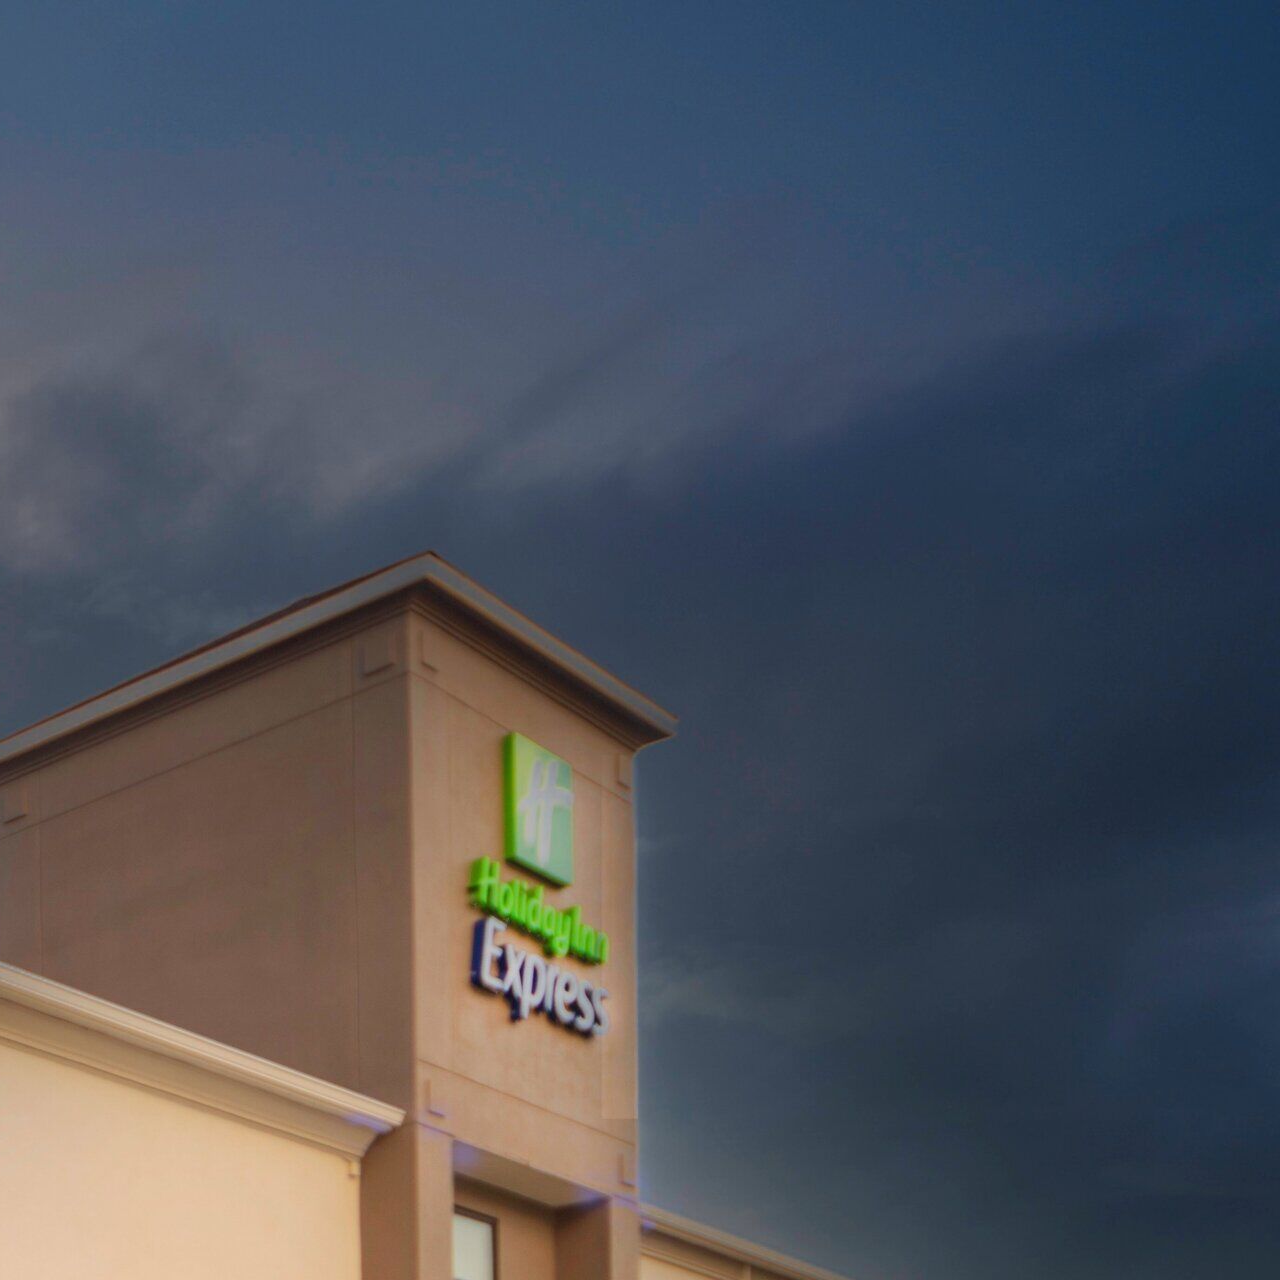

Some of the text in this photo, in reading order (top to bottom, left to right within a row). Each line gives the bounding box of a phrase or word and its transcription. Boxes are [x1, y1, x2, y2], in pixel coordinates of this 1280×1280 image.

[472, 856, 608, 965] Holiday Inn
[475, 915, 610, 1036] Express
